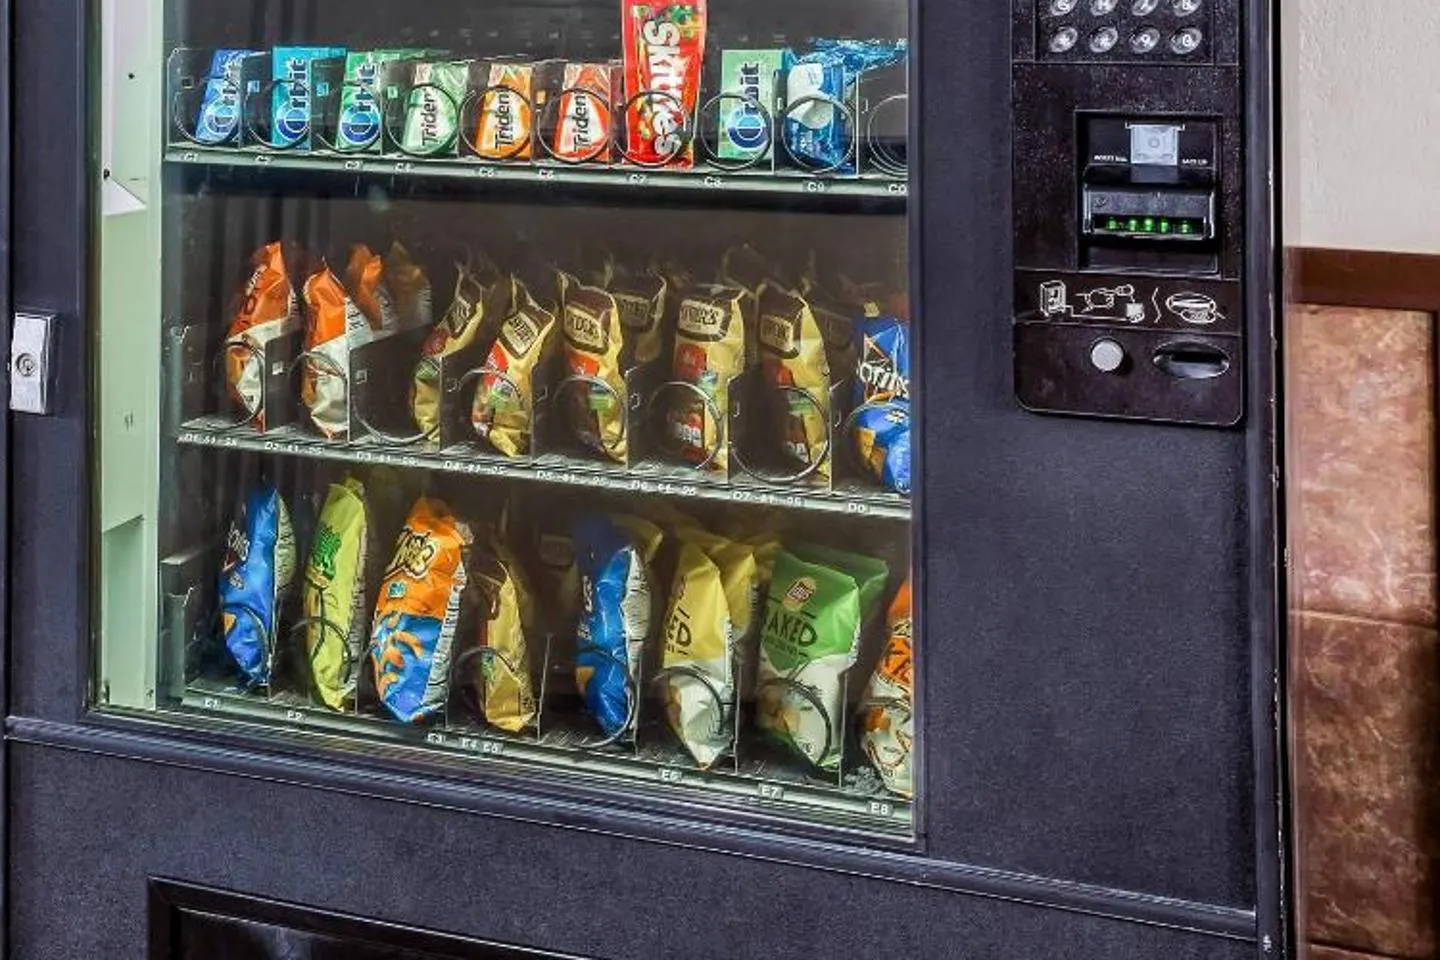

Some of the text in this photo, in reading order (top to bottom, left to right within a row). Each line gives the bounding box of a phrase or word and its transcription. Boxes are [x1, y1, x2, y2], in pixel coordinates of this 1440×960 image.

[275, 56, 309, 141] Orbit
[339, 58, 381, 144] Orbit
[422, 85, 438, 146] Triden
[494, 90, 511, 150] Triden
[573, 90, 587, 152] Triden
[761, 785, 778, 797] E7
[870, 803, 888, 816] E8
